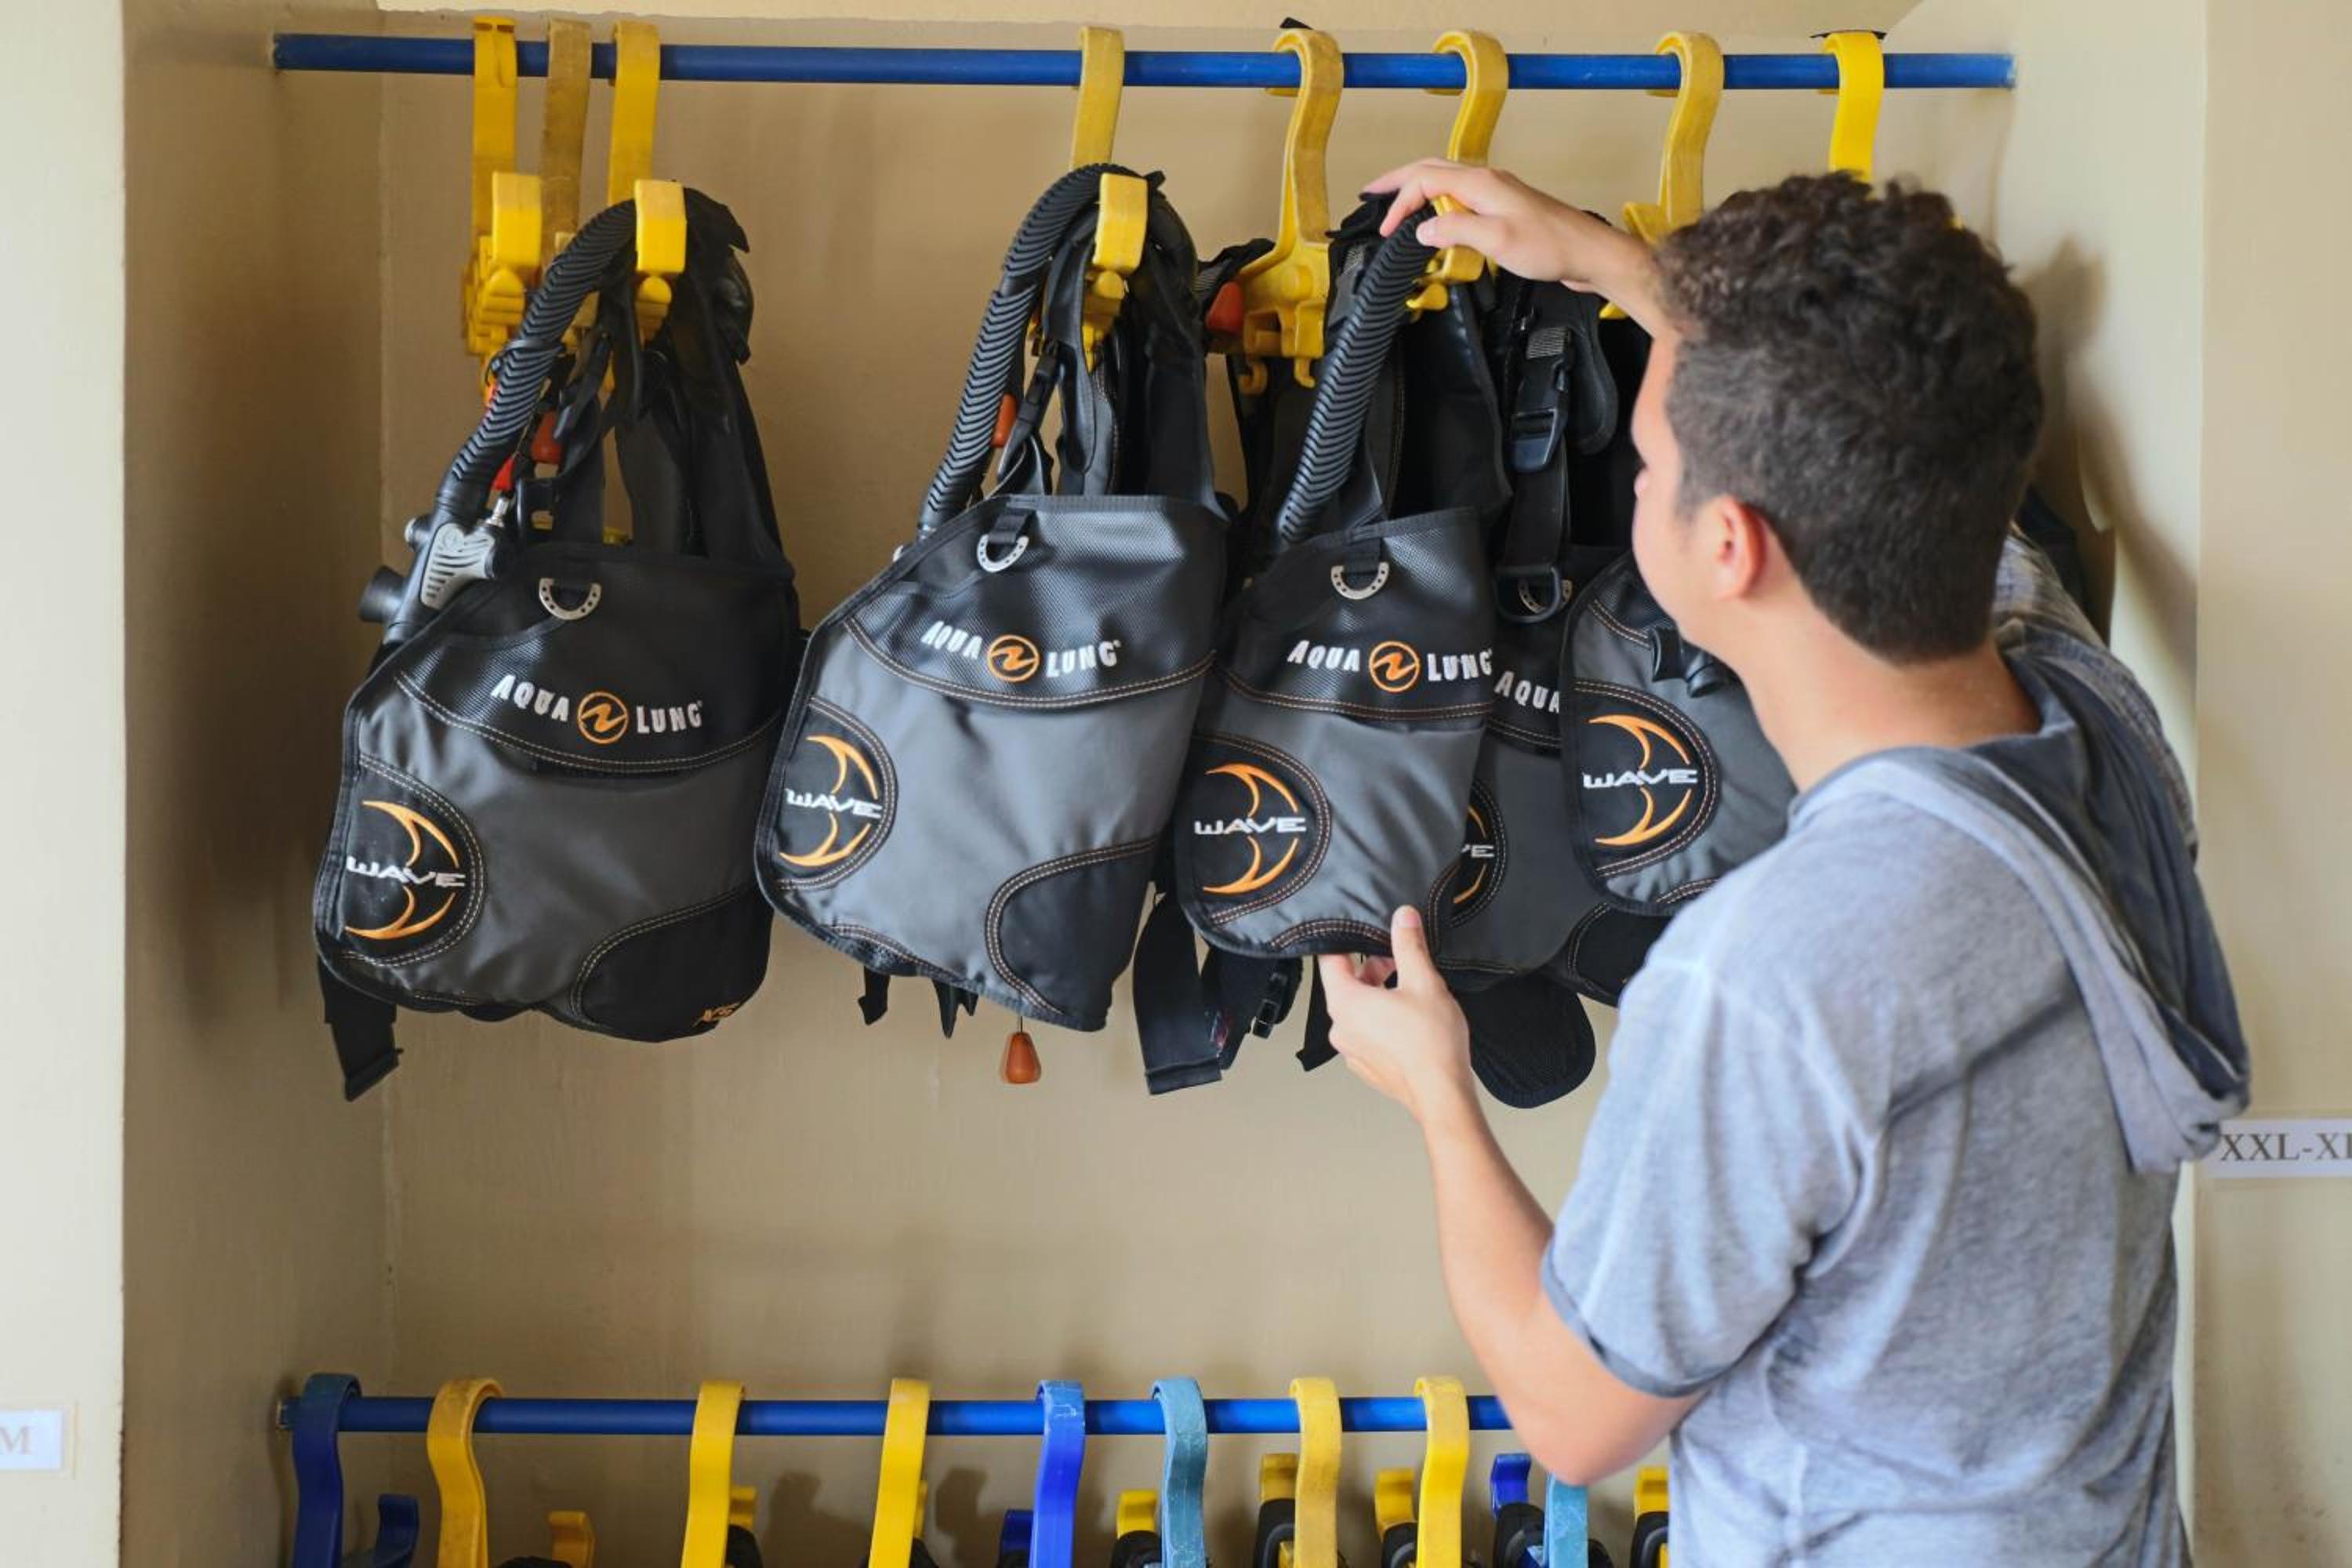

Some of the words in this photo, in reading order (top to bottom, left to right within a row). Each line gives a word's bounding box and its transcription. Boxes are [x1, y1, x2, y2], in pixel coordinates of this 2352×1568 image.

[920, 620, 982, 660] AQUA
[1287, 639, 1360, 672] AQUA
[491, 674, 568, 721] AQUA
[1494, 670, 1560, 713] AQUA
[1582, 768, 1698, 788] WAVE
[786, 788, 883, 819] WAVE
[1194, 817, 1307, 835] WAVE
[346, 856, 466, 887] WAVE
